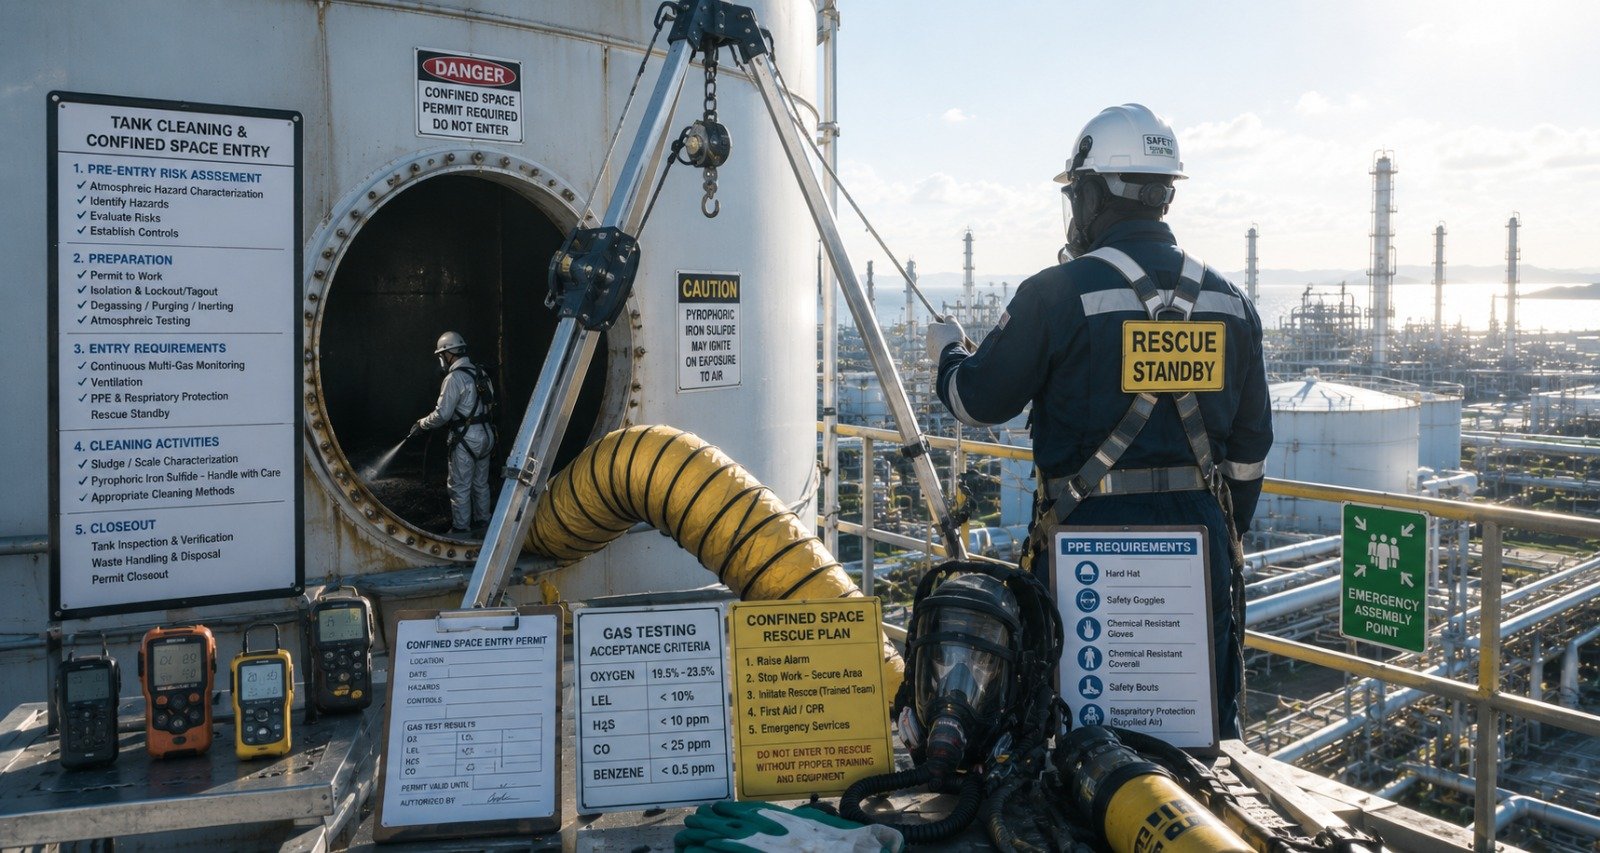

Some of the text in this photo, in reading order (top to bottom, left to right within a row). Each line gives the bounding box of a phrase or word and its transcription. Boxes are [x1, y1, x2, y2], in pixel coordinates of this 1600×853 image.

[435, 60, 505, 83] DANGER
[425, 87, 515, 106] CONFINED SPACE
[423, 102, 518, 121] PERMIT REQUIRED
[111, 116, 233, 137] TANK CLEANING
[433, 118, 508, 135] DO NOT ENTER
[86, 134, 270, 158] CONFINED SPACE ENTRY
[88, 164, 187, 180] PRE-ENTRY RISK
[90, 182, 264, 198] Atmosphreic Hazard Characterization
[90, 197, 169, 209] Identify Hazards
[90, 211, 161, 223] Evaluate Risks
[90, 226, 179, 238] Establish Controls
[89, 254, 173, 265] PREPARATION
[90, 271, 163, 280] Permit to Work
[90, 286, 218, 297] Isolation Lockout/Tagout
[683, 279, 737, 298] CAUTION
[90, 301, 233, 313] Degassing Purging Inerting
[686, 309, 735, 320] PYROPHORIC
[90, 316, 191, 327] Atmosphreic Testing
[686, 325, 704, 336] IRON
[691, 340, 730, 351] MAY IGNITE
[1133, 331, 1216, 352] RESCUE
[89, 343, 227, 354] ENTRY REQUIREMENTS
[90, 360, 245, 372] Continuous Multi-Gas Monitoring
[686, 355, 736, 367] ON EXPOSURE
[700, 371, 723, 382] TO AIR
[1133, 361, 1215, 382] STANDBY
[91, 377, 143, 387] Ventilation
[91, 392, 228, 404] PPE Respriatory Protection
[91, 409, 170, 420] Rescue Standby
[89, 436, 219, 451] CLEANING ACTIVITIES
[91, 455, 238, 470] Sludge Scale Characterization
[91, 469, 281, 488] Pyrophoric Iron Sulfide Handle with Care
[91, 486, 235, 504] Appropriate Cleaning Methods
[90, 519, 156, 534] CLOSEOUT
[92, 533, 233, 551] Tank Inspection Verification
[1068, 542, 1191, 553] PPE REQUIREMENTS
[92, 549, 221, 568] Waste Handling Disposal
[92, 570, 169, 584] Permit Closeout
[1107, 596, 1131, 605] Safety
[1348, 588, 1420, 612] EMERGENCY
[747, 611, 864, 626] CONFINED SPACE
[1355, 604, 1412, 626] ASSEMBLY
[603, 624, 696, 640] GAS TESTING
[763, 628, 850, 642] RESCUE PLAN
[1366, 622, 1399, 637] POINT
[406, 636, 548, 650] CONFINED SPACE ENTRY PERMIT
[590, 641, 710, 656] ACCEPTANCE CRITERIA
[757, 655, 810, 666] Raise Alarm
[1108, 650, 1182, 658] Chemical Resistant
[410, 657, 444, 665] LOCATION
[590, 666, 715, 682] OXYGEN 19.5% 23.5%
[758, 672, 778, 683] Stop
[780, 671, 803, 681] Work
[811, 670, 840, 679] Secure
[819, 684, 876, 697] (Trained Team)
[1109, 683, 1134, 693] Safety
[592, 691, 694, 706] LEL 10%
[760, 704, 824, 716] First Aid CPR
[1156, 707, 1195, 715] Protection
[425, 722, 442, 730] TEST
[671, 716, 683, 725] 10
[686, 716, 709, 727] ppm
[761, 723, 810, 734] Emergency
[593, 739, 711, 755] CO 25 ppm
[757, 745, 871, 759] DO NOT ENTER TO RESCUE
[593, 763, 715, 780] BENZENE 0.5 ppm
[756, 762, 796, 771] WITHOUT
